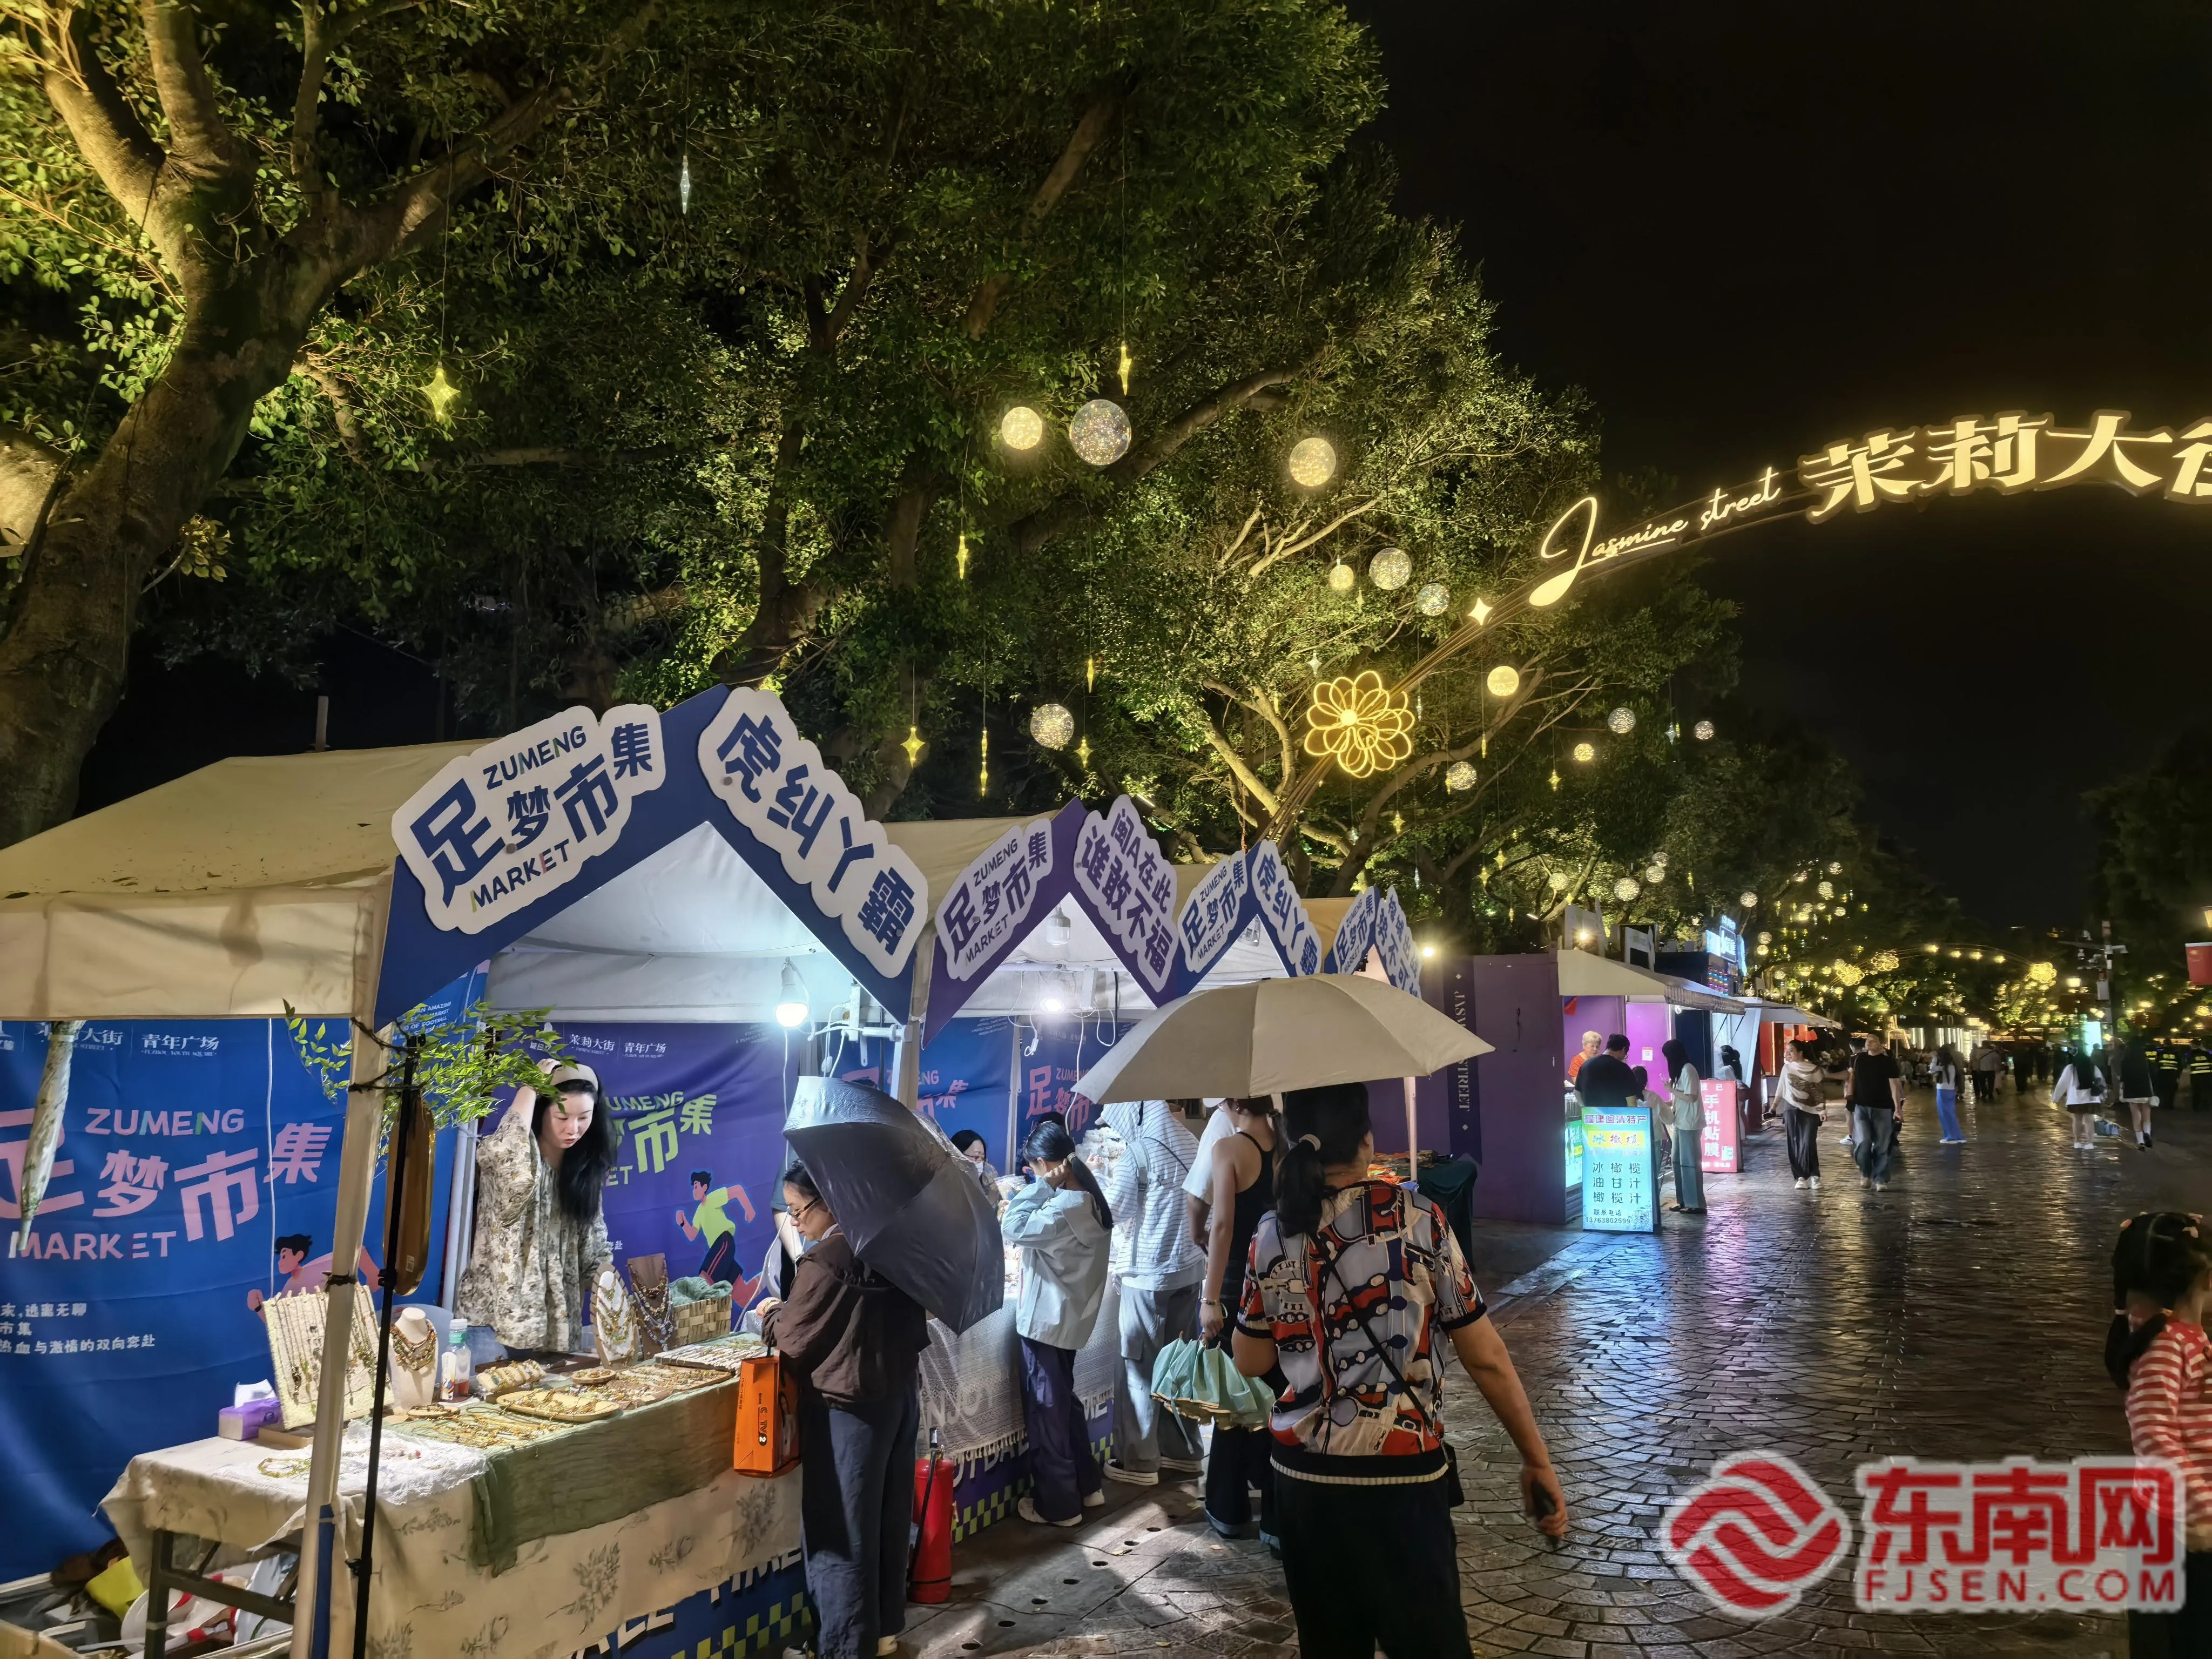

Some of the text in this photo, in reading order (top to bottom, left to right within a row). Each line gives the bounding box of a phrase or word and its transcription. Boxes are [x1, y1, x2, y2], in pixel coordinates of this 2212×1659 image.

[1529, 467, 1781, 606] Jasmine street
[483, 725, 587, 790] ZUMENG
[410, 722, 652, 907] 足梦市集
[716, 712, 914, 956] 虎纠丫霸
[470, 839, 570, 913] MARKET
[973, 838, 1018, 887] ZUMENG
[1110, 808, 1171, 914] 闽A在此
[1199, 865, 1228, 903] ZUMENG
[943, 831, 1047, 965] 足梦市集
[1081, 825, 1173, 979] 谁敢不福
[1182, 860, 1244, 961] 足梦市集
[1257, 853, 1318, 975] 虎纠丫霸
[966, 914, 1008, 967] MARKET
[1197, 923, 1224, 962] MARKET
[1336, 894, 1374, 973] 足梦市集
[141, 1034, 219, 1050] 青年广场
[569, 1034, 615, 1051] 茉莉大街
[624, 1042, 666, 1054] 青年广场
[85, 1108, 245, 1136] ZUMENG
[604, 1091, 684, 1111] UMENG
[1026, 1065, 1090, 1132] 足梦市
[1584, 1114, 1647, 1124] 福建闽清特产
[1703, 1094, 1721, 1157] 手机贴膜
[1593, 1162, 1641, 1174] 冰橄榄
[1593, 1177, 1641, 1189] 油甘汁
[1593, 1191, 1642, 1204] 橄榄汁
[8, 1231, 177, 1260] MARKET
[0, 1321, 32, 1336] 市集
[758, 1407, 768, 1446] CTV2
